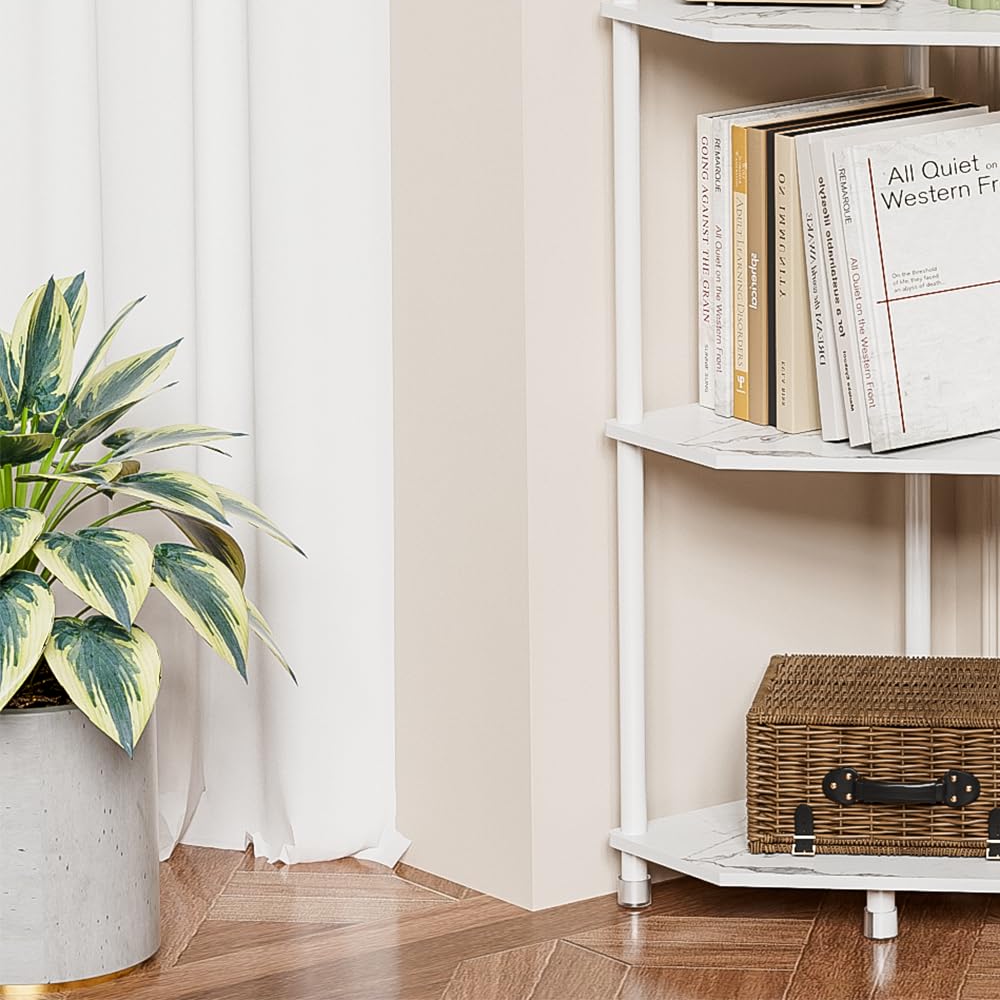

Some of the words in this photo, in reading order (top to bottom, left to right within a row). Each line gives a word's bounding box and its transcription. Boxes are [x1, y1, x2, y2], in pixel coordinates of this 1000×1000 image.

[701, 136, 709, 181] GOING
[714, 138, 722, 193] REMARQUE
[888, 163, 915, 186] All
[921, 154, 980, 180] Quiet
[985, 161, 998, 170] on
[838, 168, 852, 225] REMARQUE
[881, 184, 971, 210] Western
[701, 184, 710, 245] AGAINST
[736, 196, 744, 236] ADULT
[715, 225, 723, 239] All
[702, 249, 710, 276] THE
[715, 270, 721, 283] on
[737, 240, 745, 300] LEARNING
[850, 257, 859, 271] All
[911, 266, 938, 275] threshold
[852, 273, 862, 300] Quiet
[703, 280, 711, 324] GRAIN
[856, 303, 863, 316] on
[715, 304, 723, 345] Western
[737, 303, 745, 367] DISORDERS
[858, 319, 866, 335] the
[716, 347, 724, 374] Front
[861, 337, 872, 380] Western
[866, 382, 876, 409] Front
